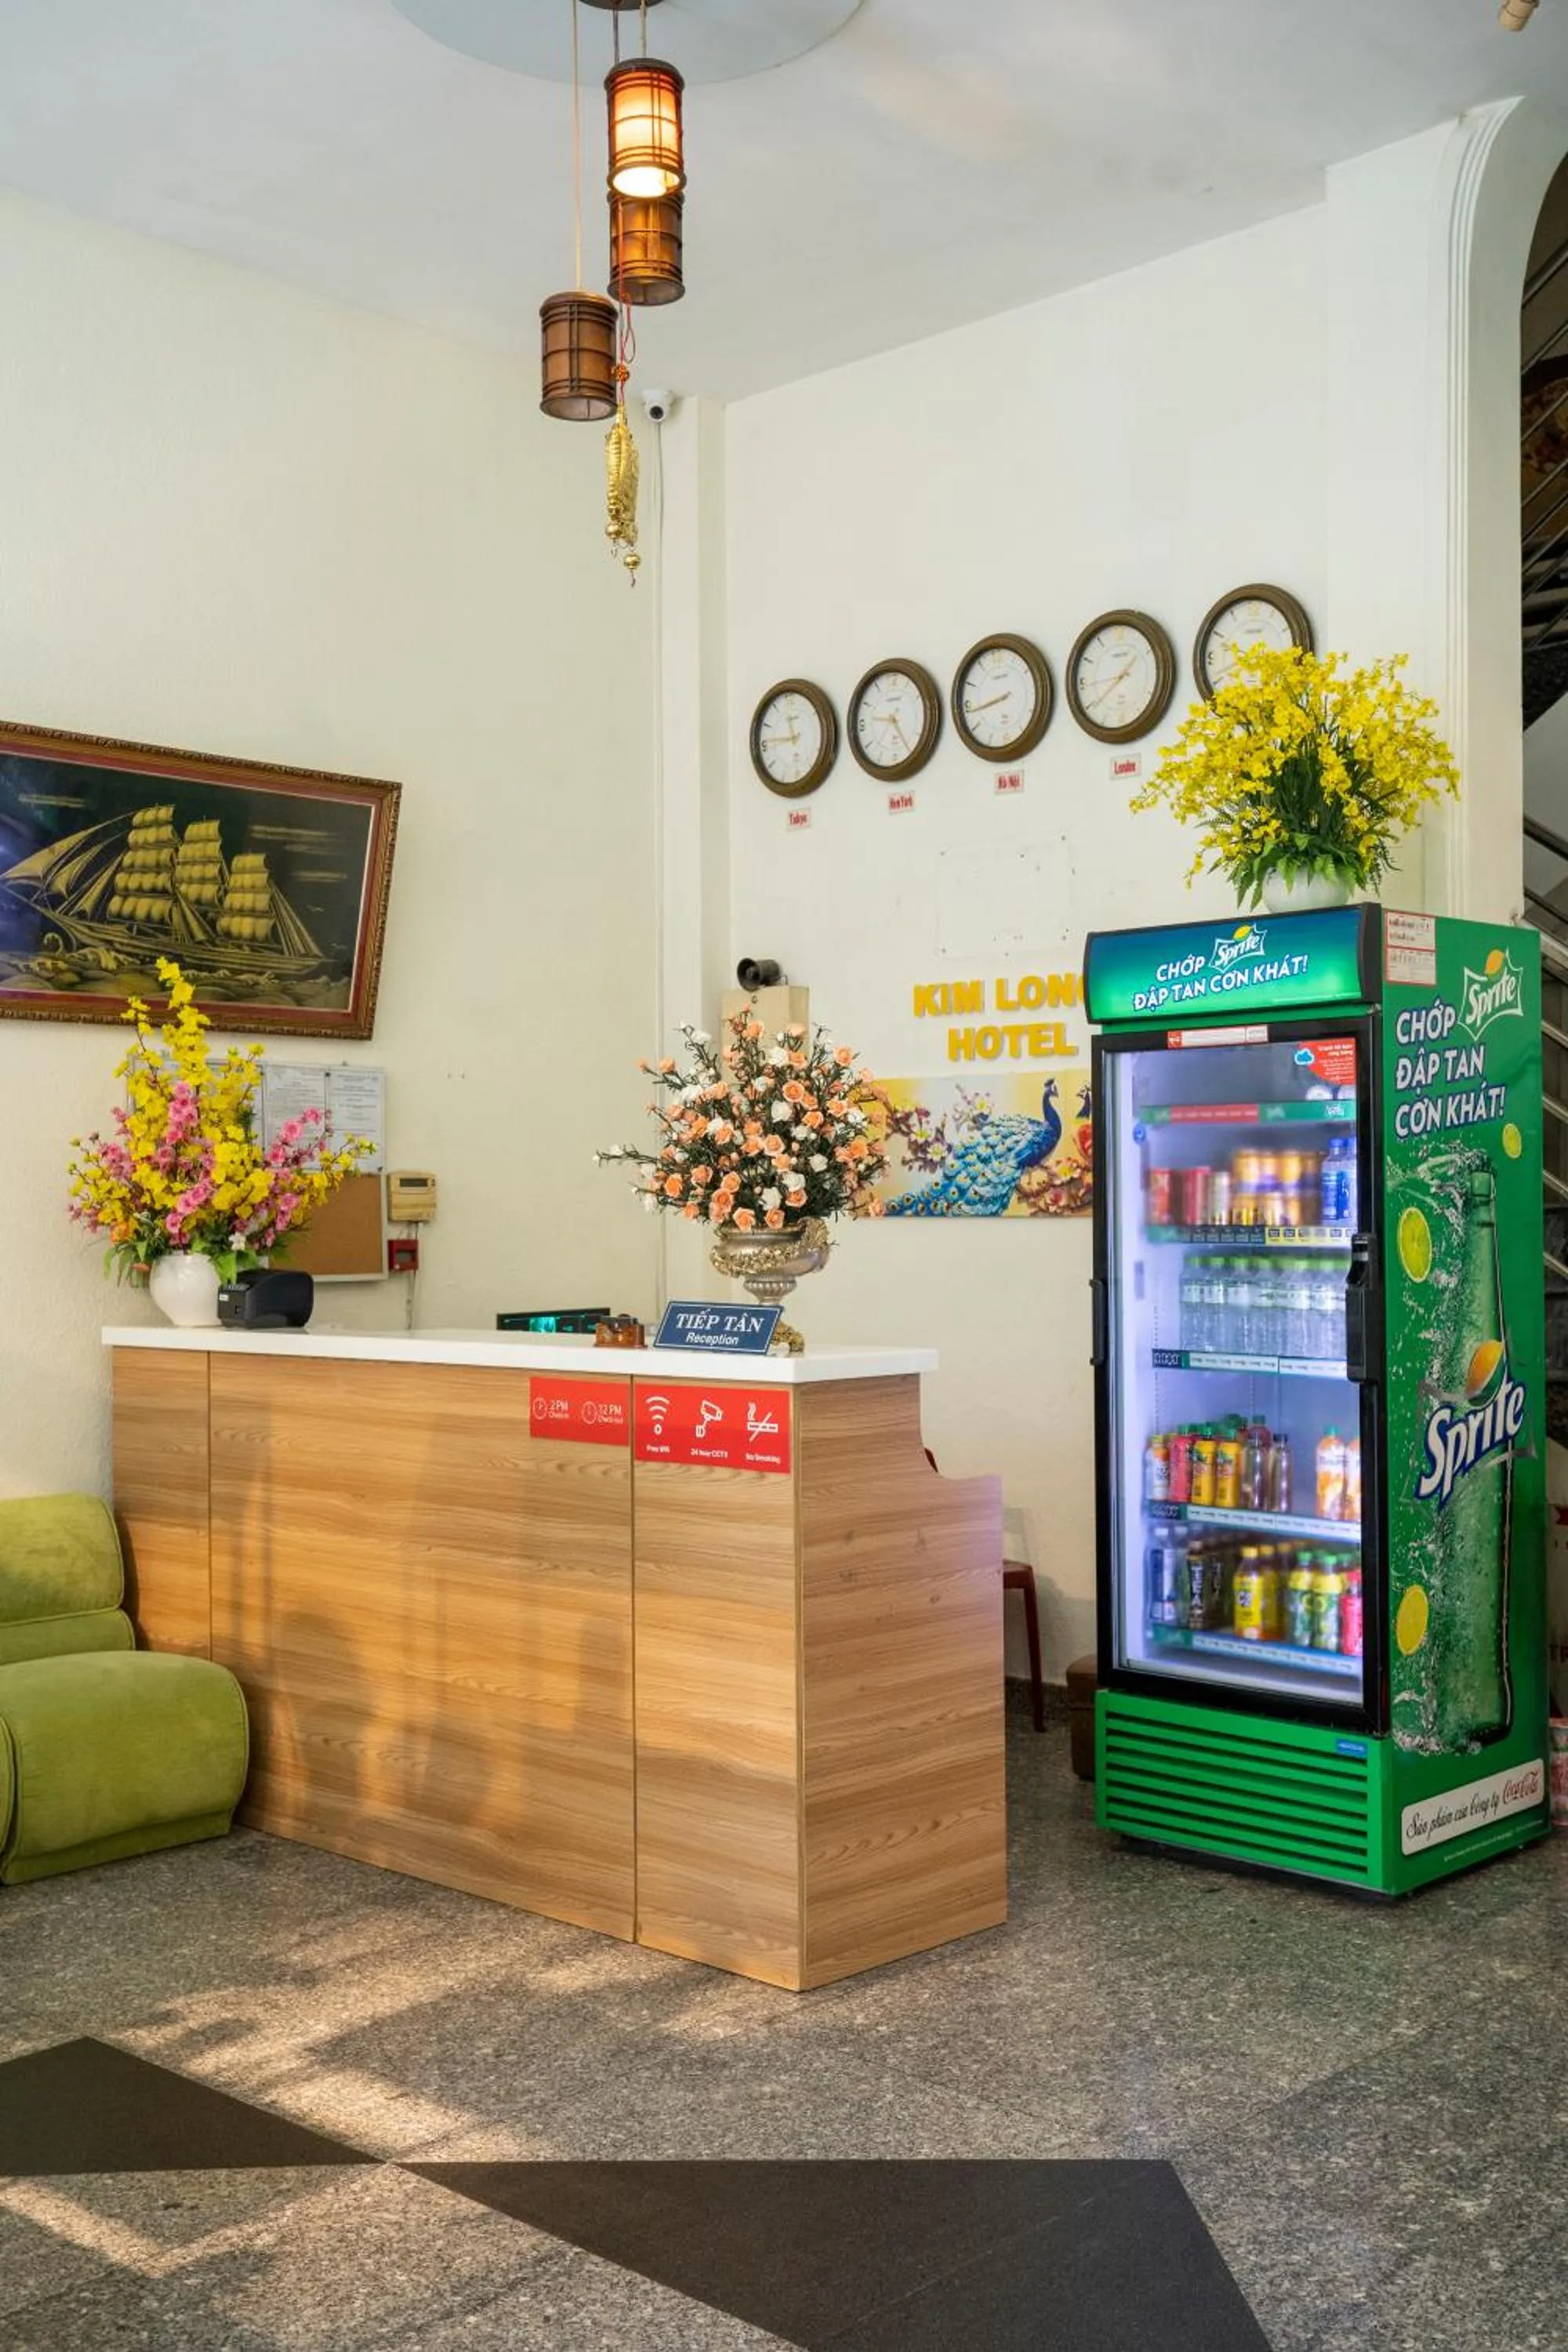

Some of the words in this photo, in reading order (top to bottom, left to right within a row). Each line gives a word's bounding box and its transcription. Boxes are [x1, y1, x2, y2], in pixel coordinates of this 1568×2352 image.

[1156, 953, 1206, 982] CHỚP
[1215, 933, 1260, 967] Sprite
[913, 979, 985, 1018] KIM
[995, 972, 1083, 1011] LON
[1134, 985, 1169, 1011] ĐẬP
[1171, 978, 1206, 1002] TAN
[1210, 968, 1250, 993] CƠN
[1252, 953, 1309, 984] KHÁT!
[1465, 966, 1518, 1028] Sprite
[948, 1022, 1079, 1062] HOTEL
[1396, 997, 1456, 1044] CHỚP
[1396, 1047, 1440, 1095] ĐẬP
[1444, 1045, 1485, 1081] TAN
[1395, 1096, 1443, 1138] CƠN
[1445, 1081, 1507, 1126] KHÁT!
[676, 1308, 720, 1330] TIẾP
[723, 1312, 765, 1333] TÂN
[685, 1331, 739, 1346] Reception
[608, 1404, 622, 1416] PM
[1418, 1370, 1526, 1502] Sprite
